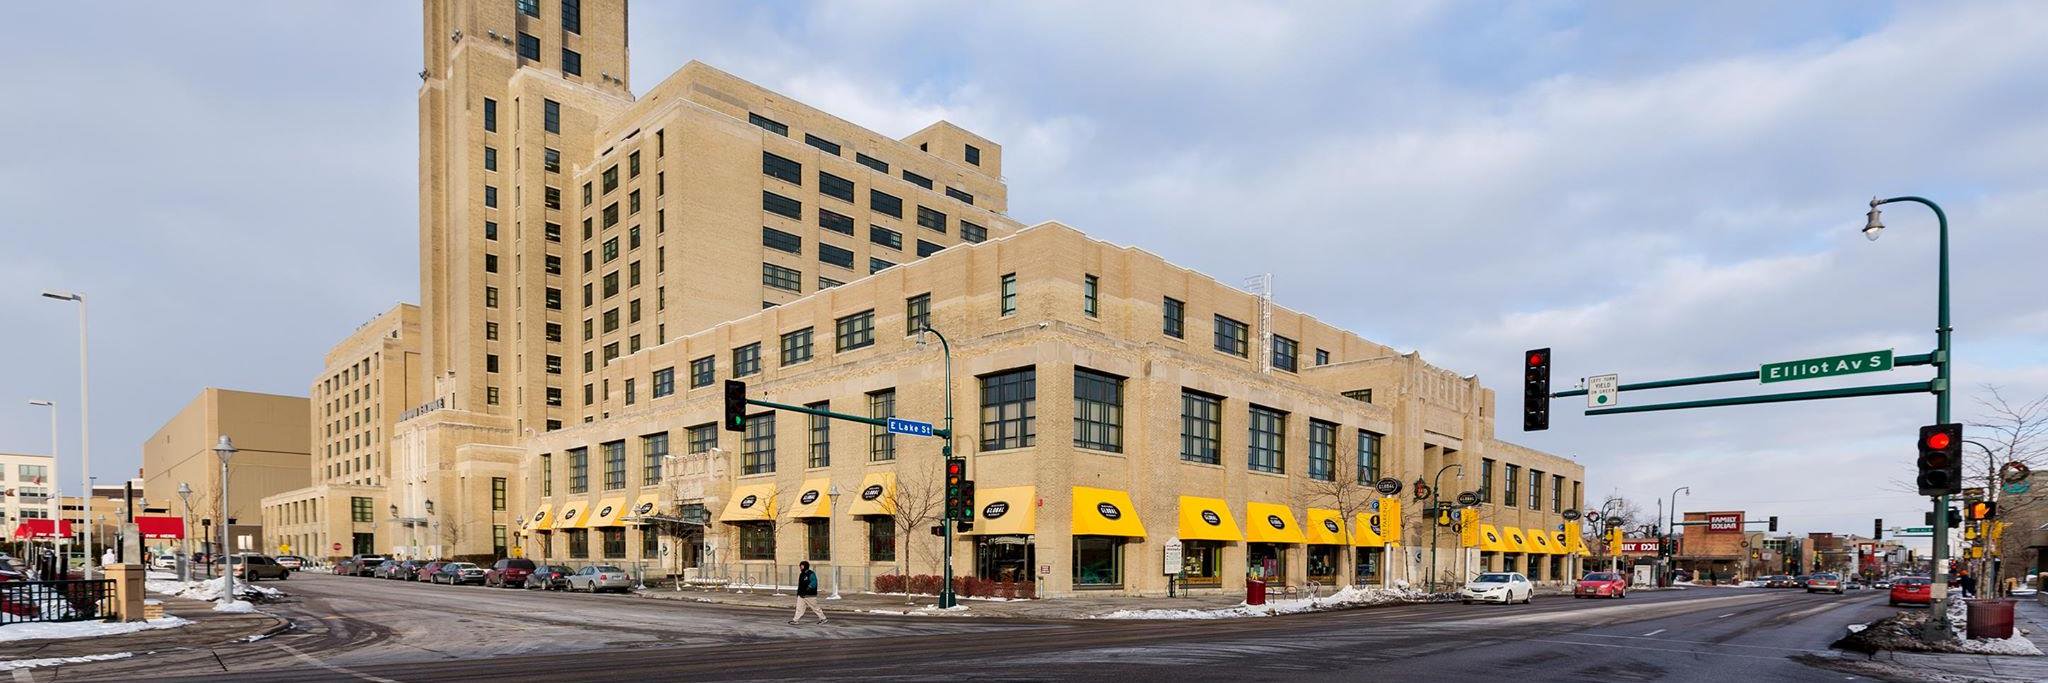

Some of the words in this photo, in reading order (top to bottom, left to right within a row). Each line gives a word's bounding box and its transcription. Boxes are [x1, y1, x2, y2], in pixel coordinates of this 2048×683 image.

[1770, 361, 1829, 378] Elliot
[1835, 359, 1862, 372] Av
[1869, 356, 1881, 367] S
[890, 421, 896, 430] E
[898, 422, 919, 433] Lake
[921, 425, 931, 434] St
[1641, 543, 1660, 551] DOLL
